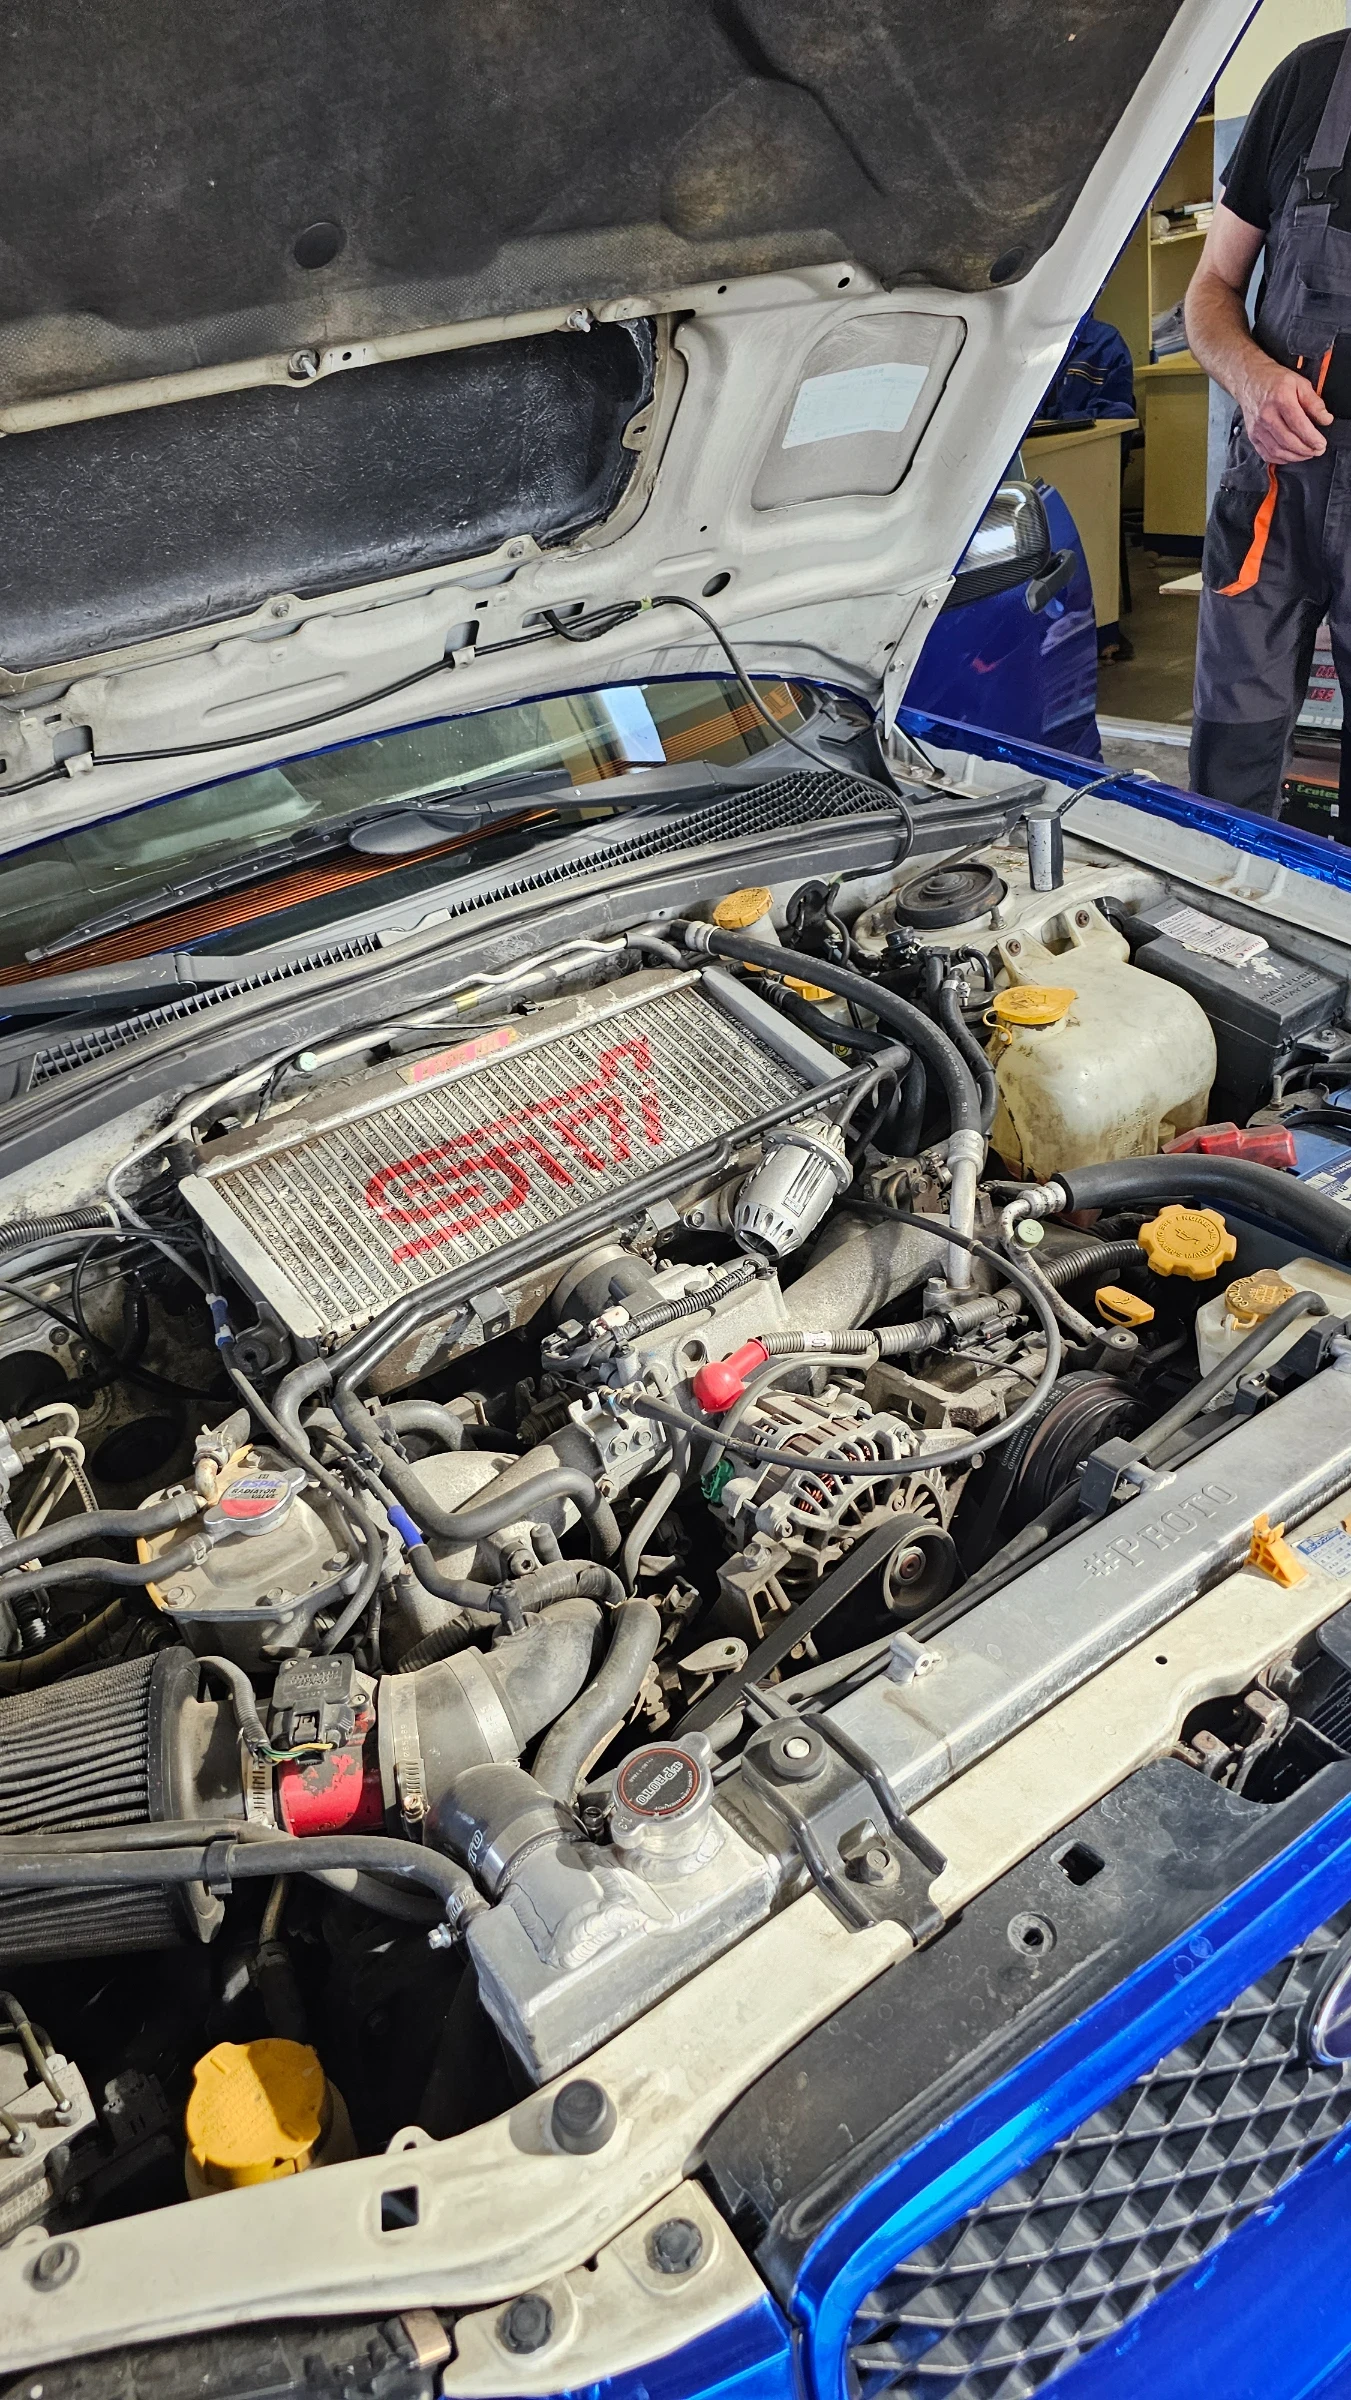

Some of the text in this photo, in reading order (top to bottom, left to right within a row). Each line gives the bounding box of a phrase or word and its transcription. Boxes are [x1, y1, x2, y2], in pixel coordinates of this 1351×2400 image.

[1243, 941, 1263, 953] TOTAL
[1259, 983, 1287, 1001] MAIN
[1228, 1275, 1256, 1307] COOLANT
[1007, 1428, 1029, 1471] Continental
[1083, 1481, 1238, 1577] #PROTO
[636, 1760, 684, 1806] #PROTO
